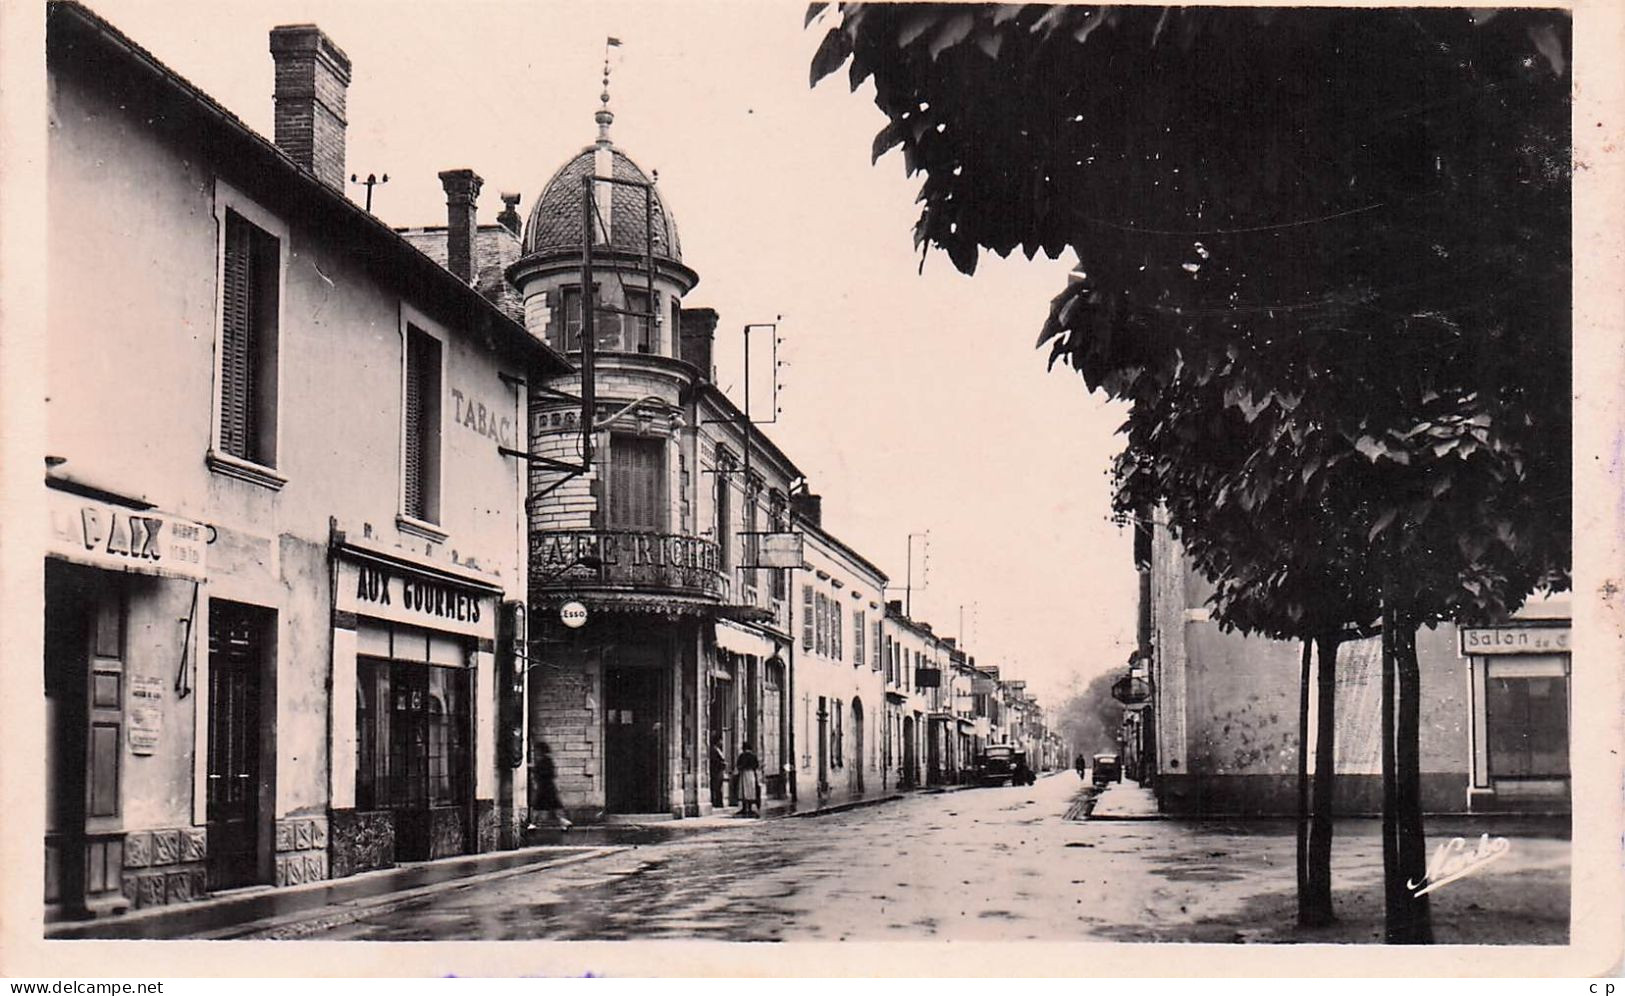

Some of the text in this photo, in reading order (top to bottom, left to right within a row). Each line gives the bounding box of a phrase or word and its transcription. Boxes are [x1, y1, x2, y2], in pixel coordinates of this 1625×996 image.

[451, 388, 510, 447] TABAC
[81, 507, 163, 560] PAIX
[356, 565, 481, 623] AUX GOURMETS
[563, 609, 585, 618] Esso
[1469, 630, 1528, 646] Salon
